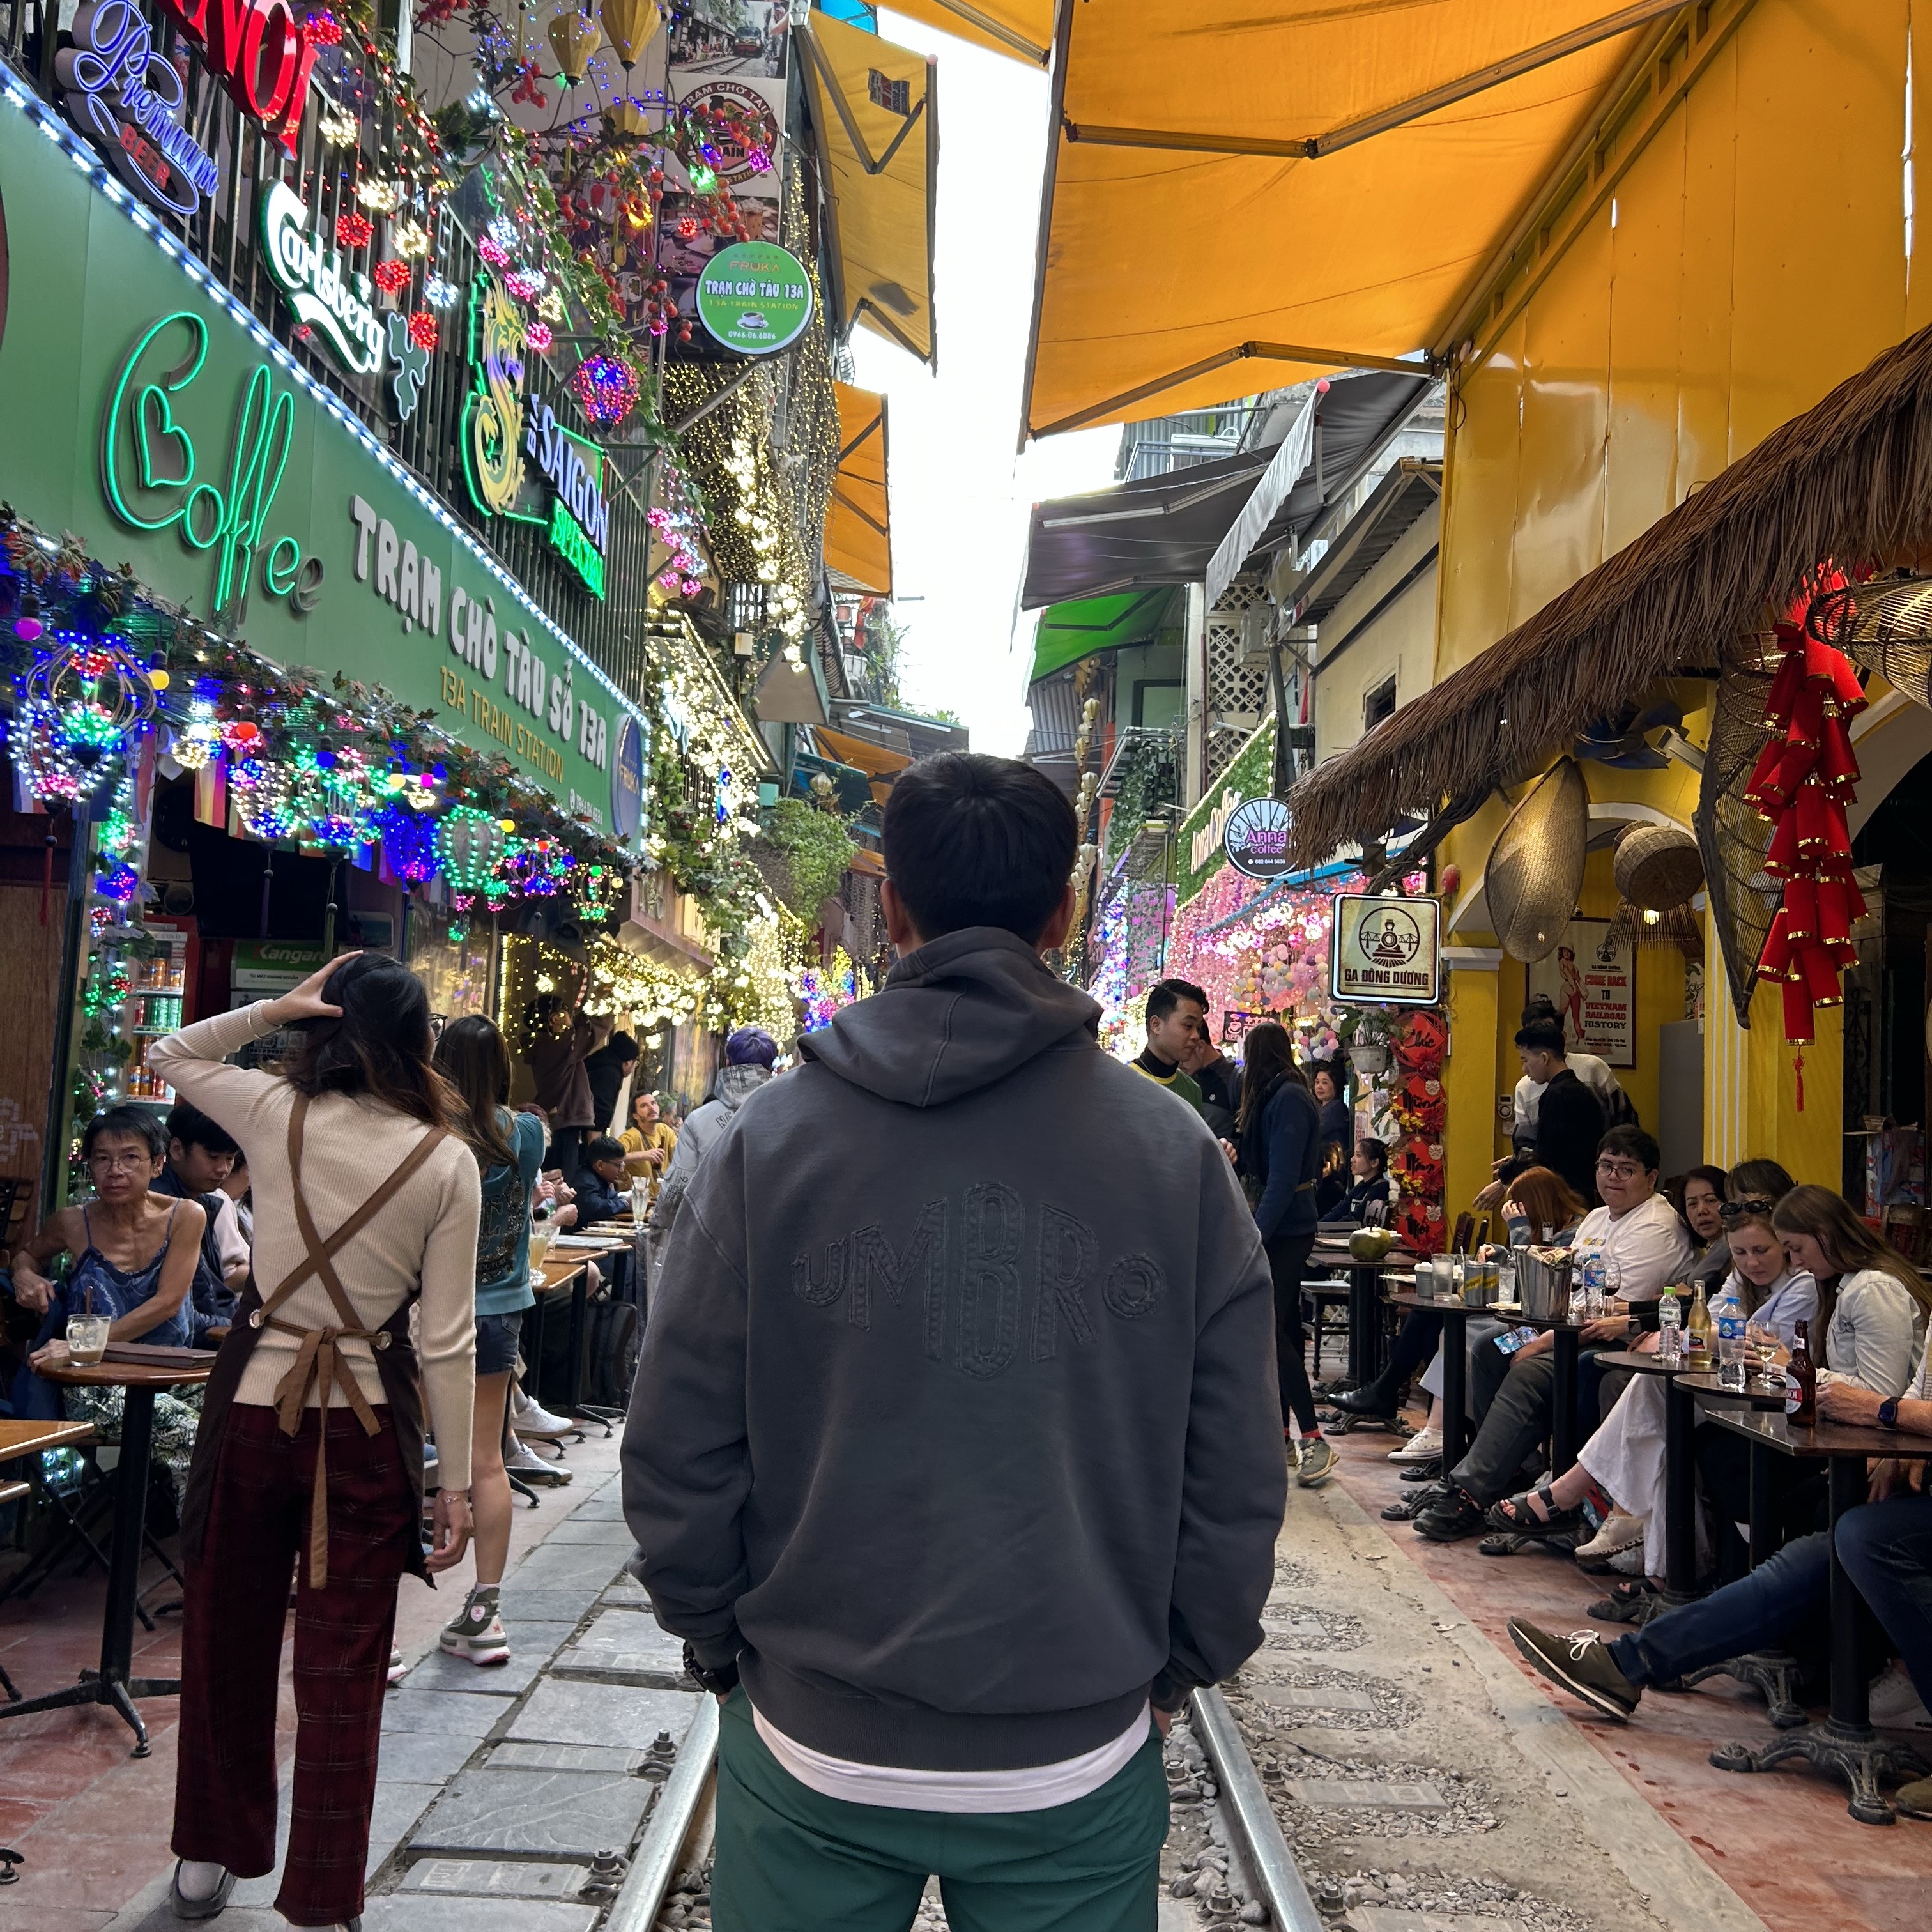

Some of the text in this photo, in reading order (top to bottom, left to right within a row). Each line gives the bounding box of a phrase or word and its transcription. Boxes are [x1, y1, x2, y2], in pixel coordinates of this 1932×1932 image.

[119, 123, 171, 190] BEER
[723, 146, 744, 158] AIN
[261, 179, 386, 374] Carlsberg
[705, 280, 733, 298] TRẠM
[759, 279, 780, 298] TÀU
[784, 284, 804, 299] 13A
[730, 300, 758, 309] TRAIN
[760, 302, 799, 311] STATION
[102, 311, 325, 632] Coffee
[539, 404, 610, 556] SAIGON
[351, 494, 442, 636] TRẠM
[503, 627, 546, 719] TÀU
[548, 658, 574, 741] SỐ
[579, 700, 606, 770] 13A
[440, 665, 564, 784] 13A TRAIN STATION
[1245, 829, 1287, 843] Anna
[1250, 845, 1283, 854] coffee
[259, 942, 325, 964] Kangar
[1344, 969, 1358, 982] GA
[1601, 989, 1611, 1000] TO
[1584, 1002, 1627, 1011] VIETNAM
[1585, 1011, 1627, 1020] RAILROAD
[1584, 1020, 1627, 1029] HISTORY
